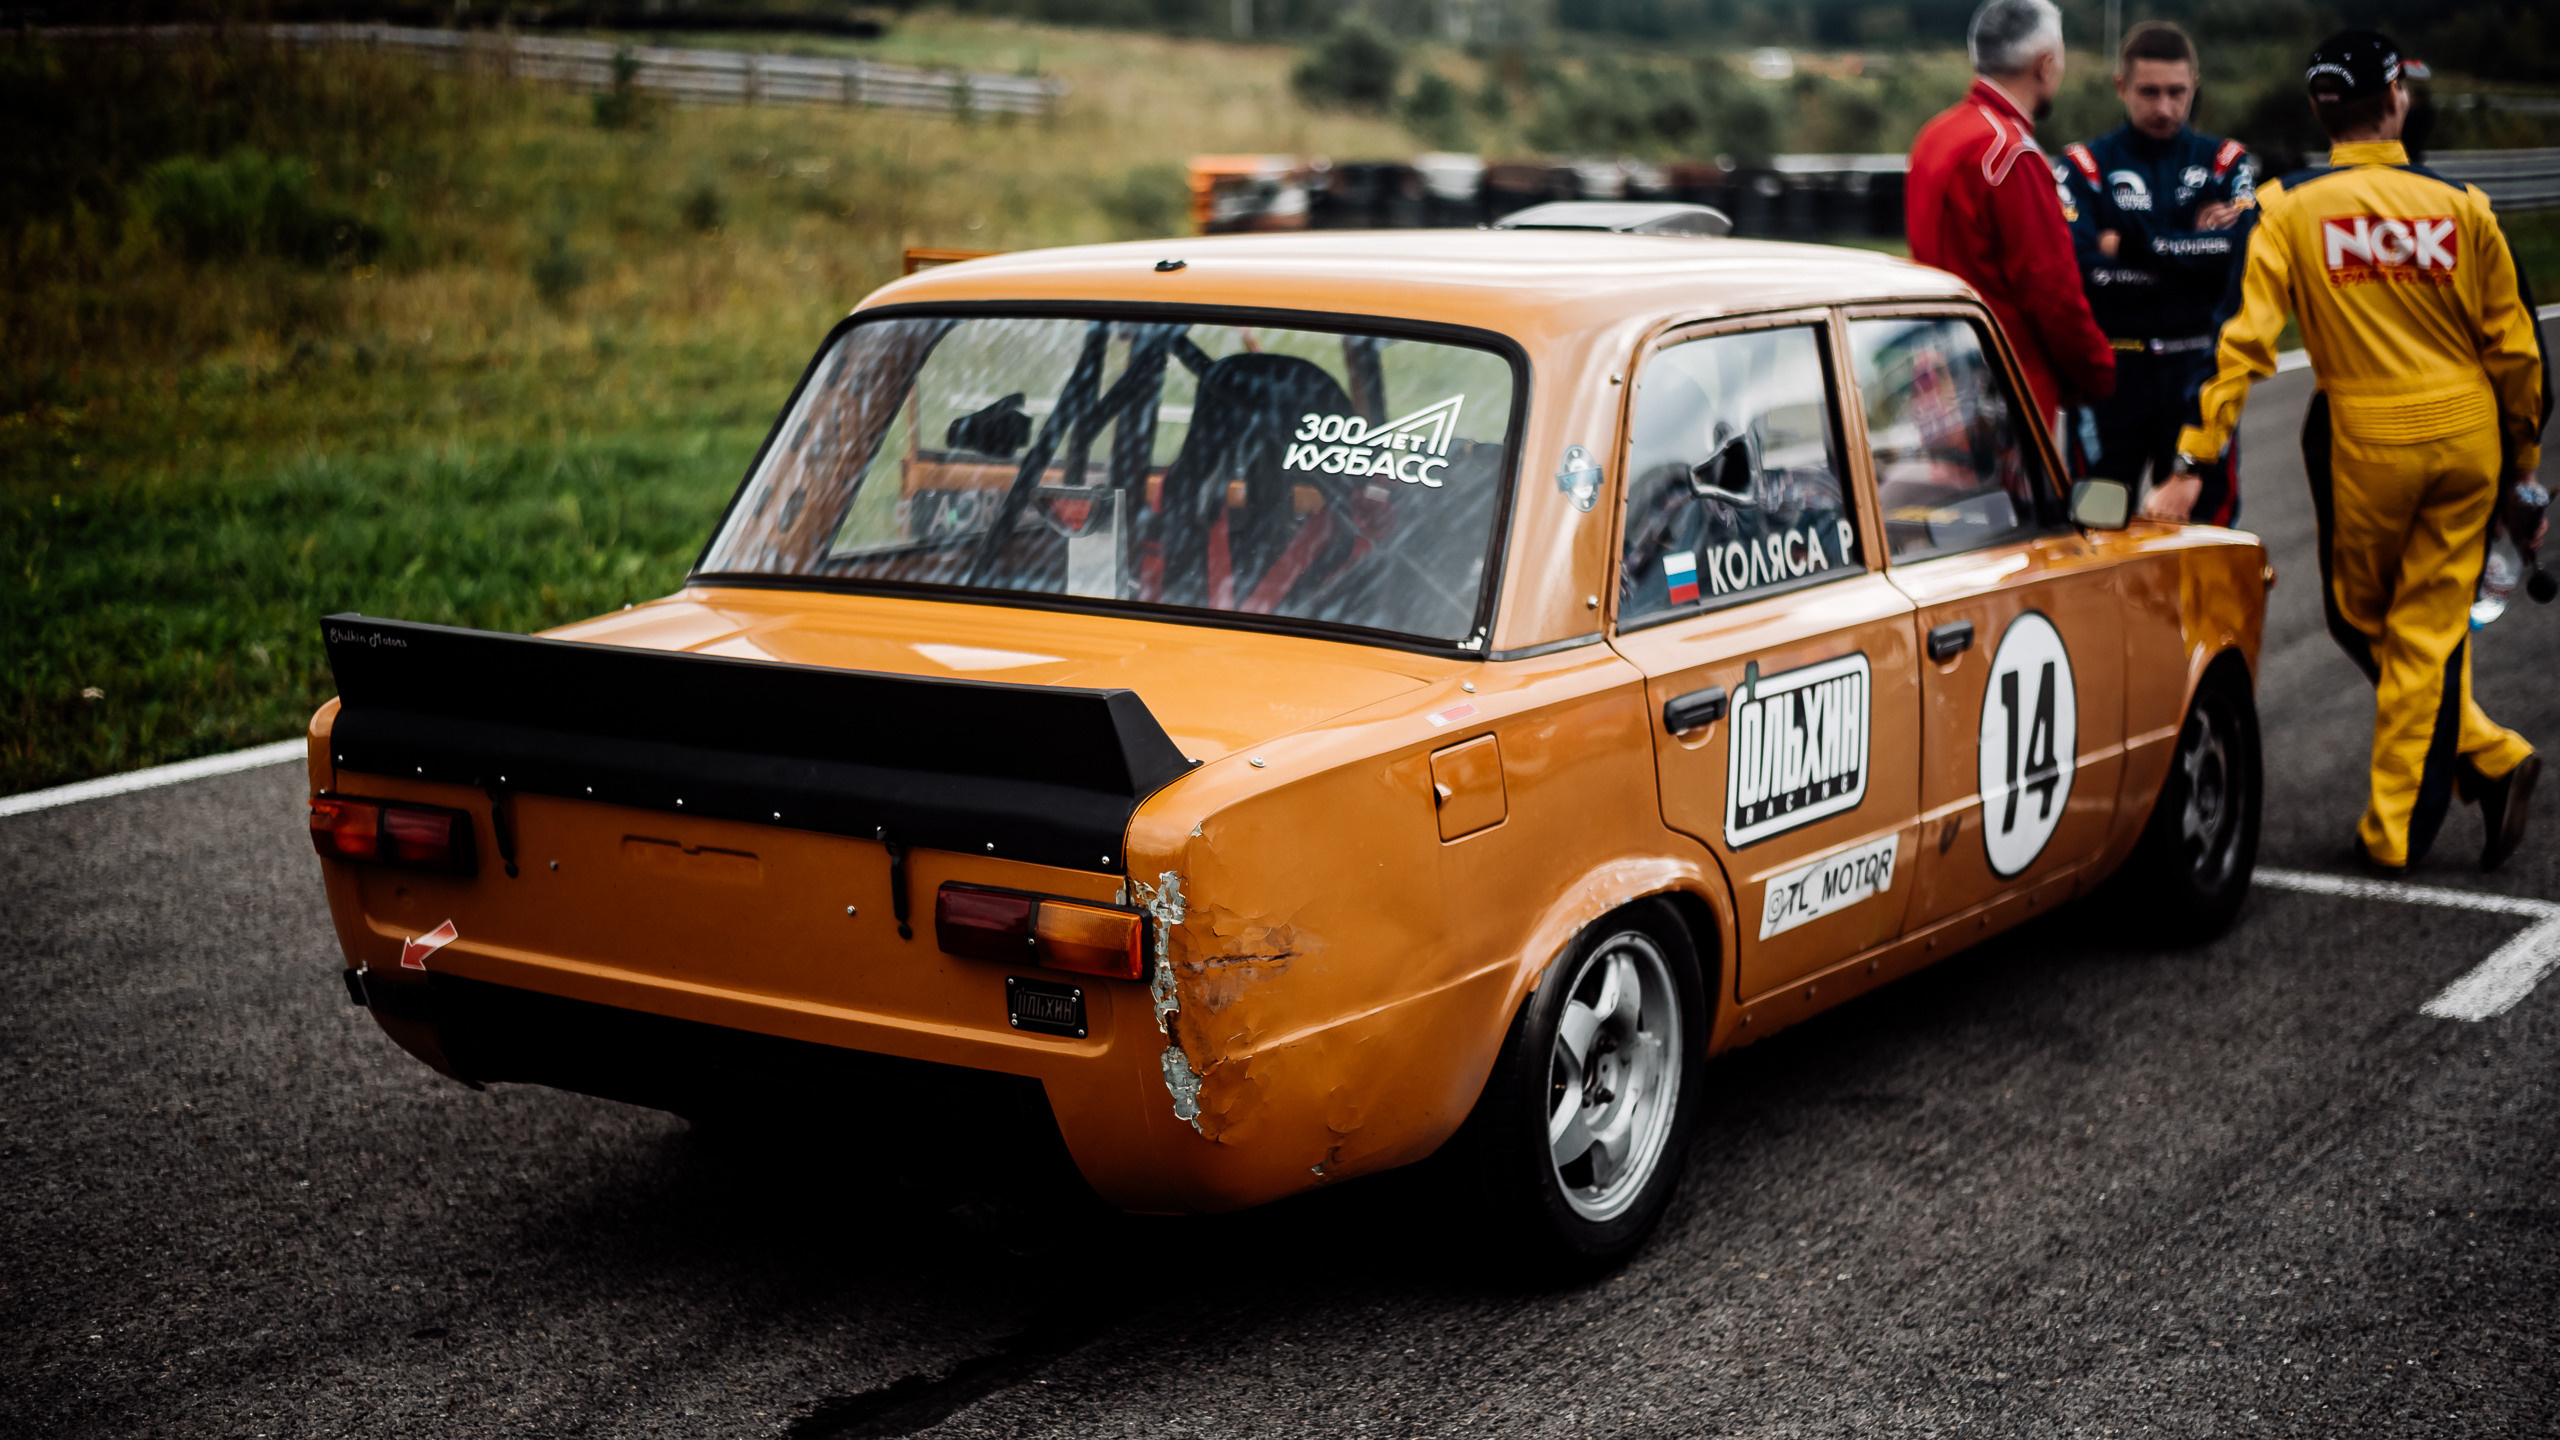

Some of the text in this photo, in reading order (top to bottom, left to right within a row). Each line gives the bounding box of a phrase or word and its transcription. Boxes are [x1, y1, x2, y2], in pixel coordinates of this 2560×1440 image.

[2324, 216, 2456, 271] NGK
[1294, 413, 1427, 452] 300 ЛЕТ
[1281, 442, 1450, 488] КУЗБАСС
[1706, 518, 1854, 596] КОЛЯСА Р
[368, 631, 408, 648] Motors
[1738, 672, 1861, 809] ОЛЬХИН
[2001, 661, 2060, 835] 14
[1745, 775, 1850, 826] RACING
[1766, 848, 1893, 924] @TL_MOTOR
